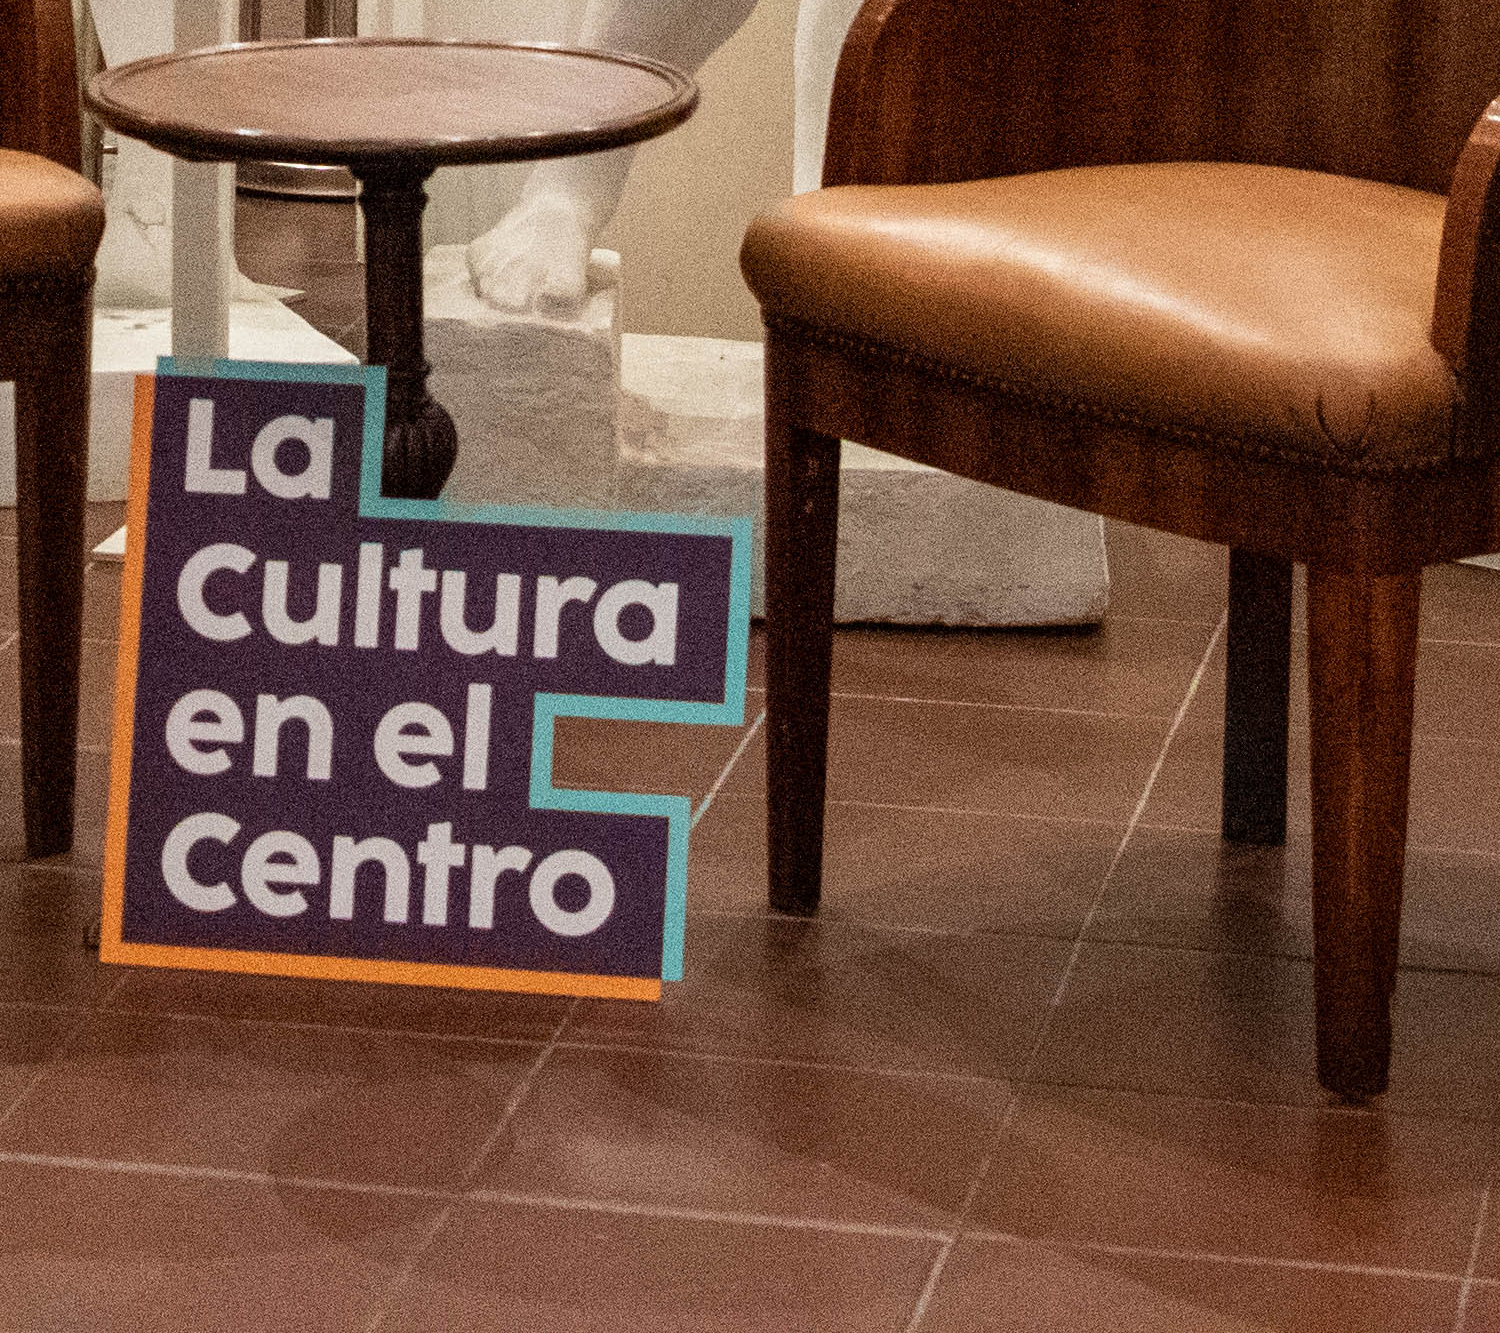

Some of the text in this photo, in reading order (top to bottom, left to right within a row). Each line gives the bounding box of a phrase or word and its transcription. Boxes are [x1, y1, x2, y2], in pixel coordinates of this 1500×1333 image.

[184, 397, 335, 501] La
[176, 542, 680, 667] Cultura
[164, 682, 492, 792] en el
[160, 811, 616, 937] Centro
